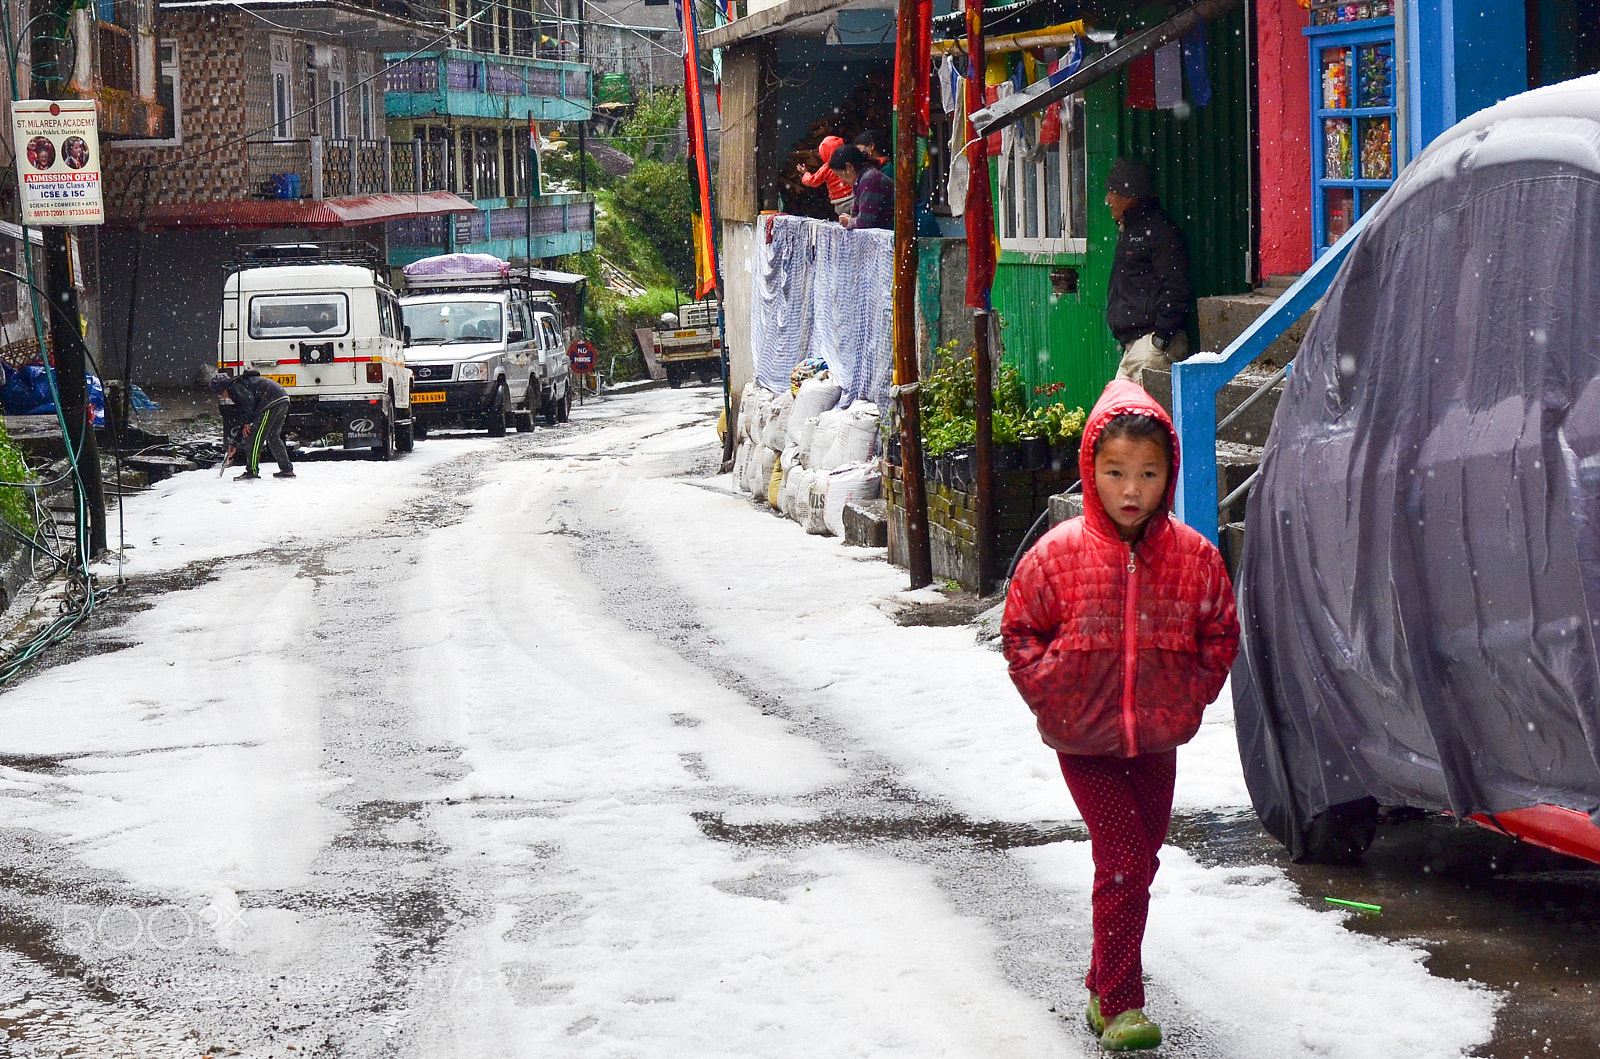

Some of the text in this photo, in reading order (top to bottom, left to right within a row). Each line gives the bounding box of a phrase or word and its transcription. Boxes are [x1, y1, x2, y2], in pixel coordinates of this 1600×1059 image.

[28, 119, 62, 128] MILAREPA
[63, 118, 95, 127] ACADEMY
[26, 173, 97, 182] ADMISSION OPEN
[41, 190, 61, 198] ICSE
[277, 376, 294, 385] 4797
